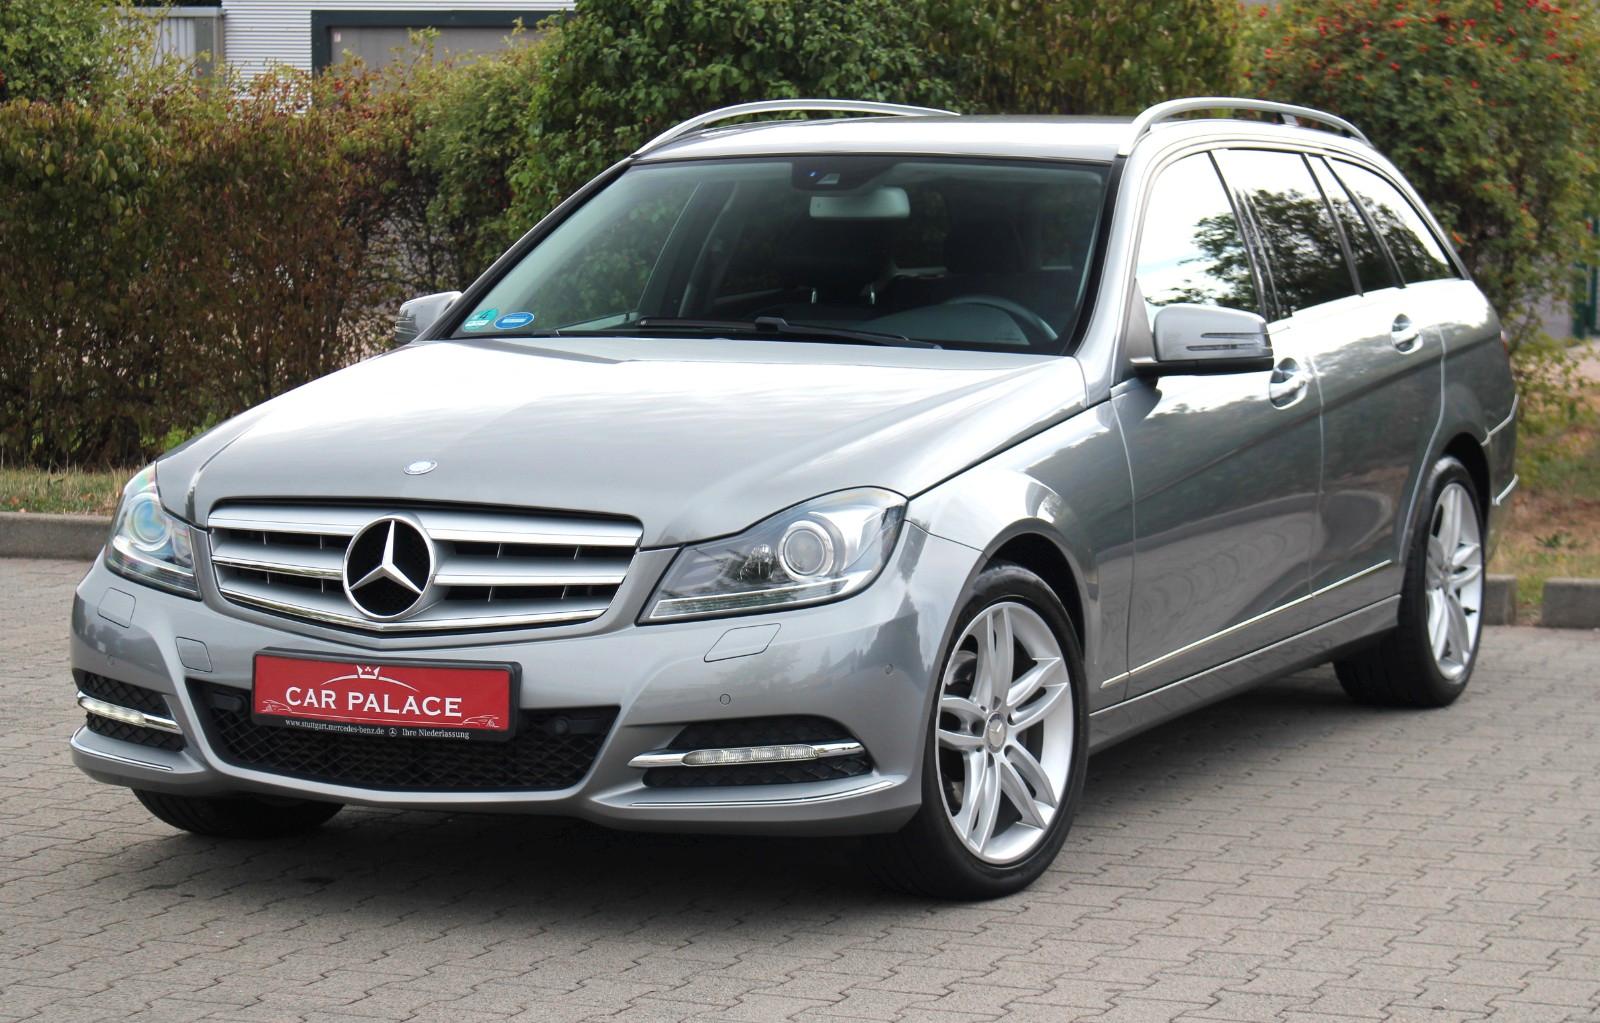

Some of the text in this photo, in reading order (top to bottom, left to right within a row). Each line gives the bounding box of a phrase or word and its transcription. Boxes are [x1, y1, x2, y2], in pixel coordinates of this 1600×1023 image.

[286, 686, 462, 717] CAR PALACE
[285, 719, 470, 739] www.stuttgart.mercedes-benz.de Ihre Niederlassung
